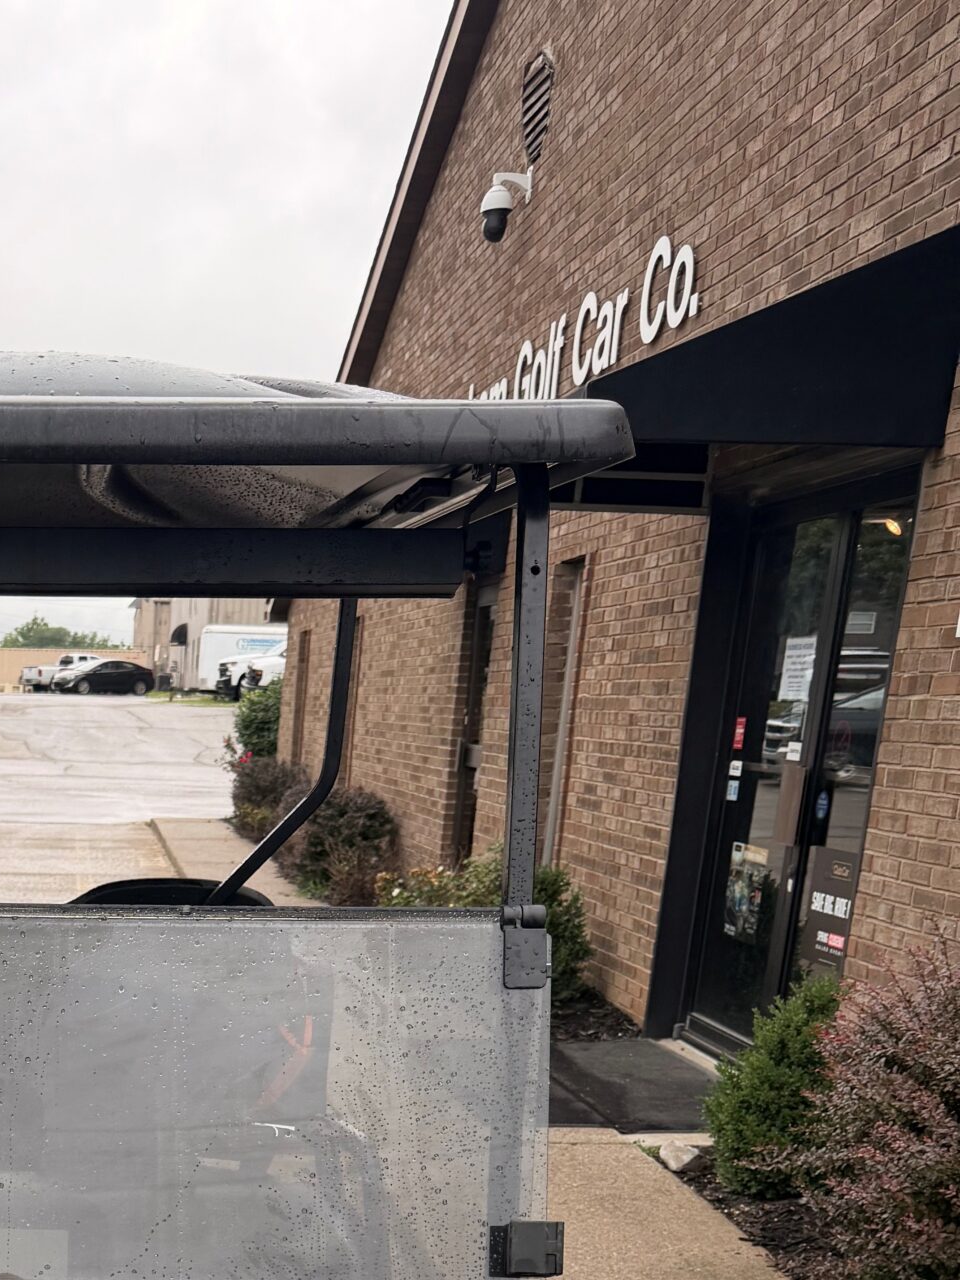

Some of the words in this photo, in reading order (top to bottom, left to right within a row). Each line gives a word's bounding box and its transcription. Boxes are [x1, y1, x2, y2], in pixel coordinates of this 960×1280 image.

[514, 313, 567, 400] Golf
[572, 287, 629, 386] Car
[639, 235, 699, 345] Co.
